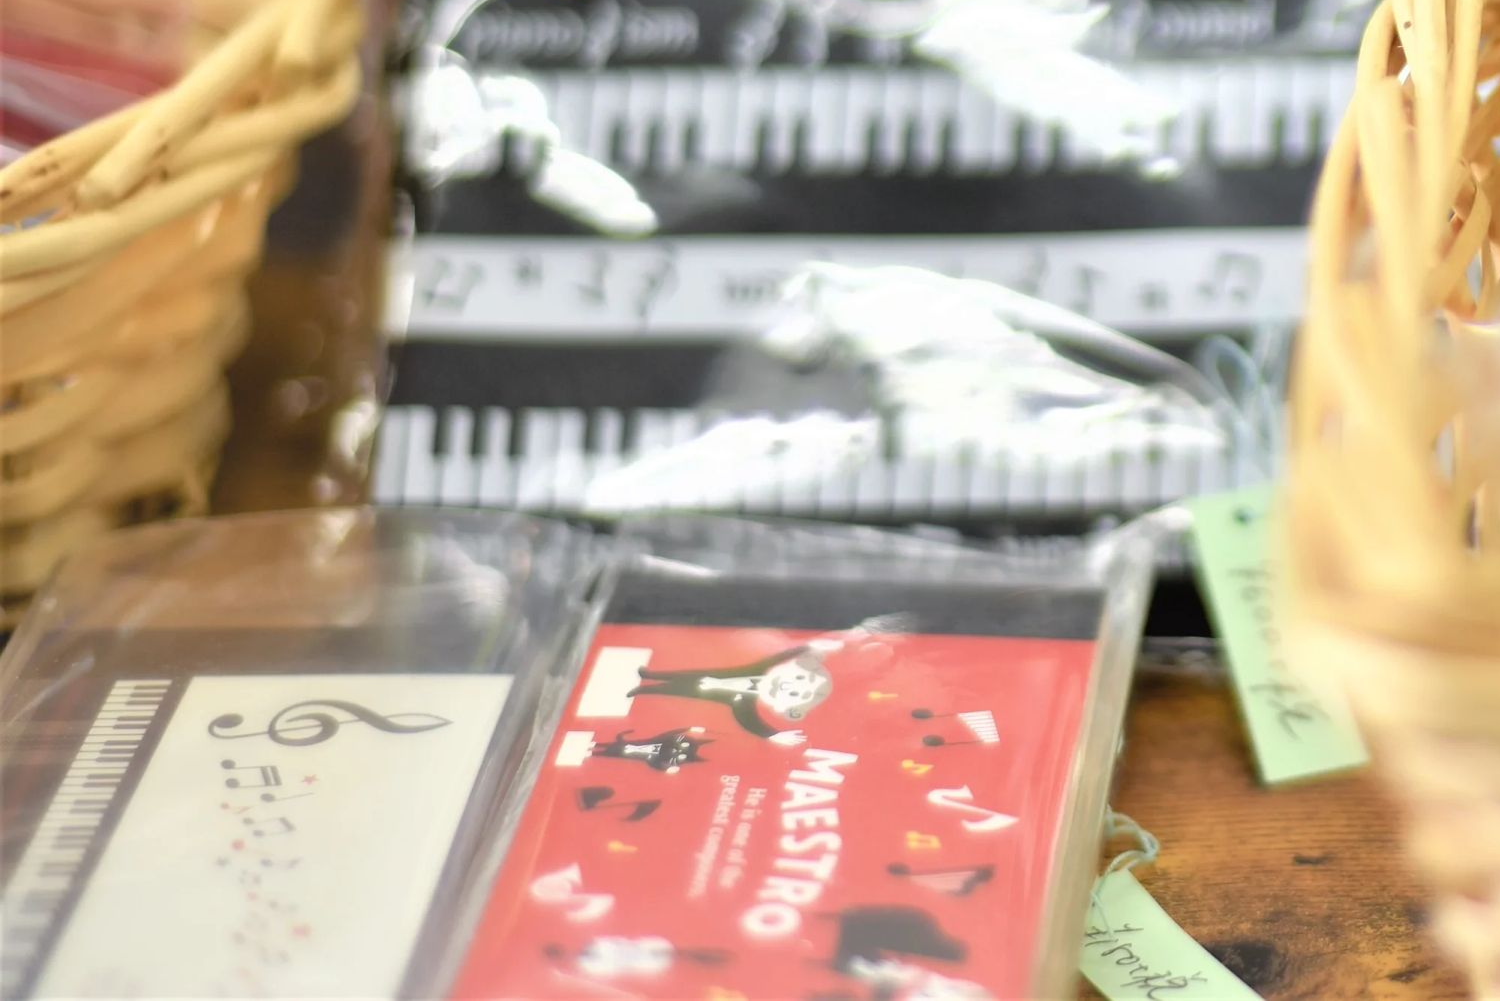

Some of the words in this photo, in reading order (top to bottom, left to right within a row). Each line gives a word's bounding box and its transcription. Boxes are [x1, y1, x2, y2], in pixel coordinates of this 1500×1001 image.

[711, 775, 741, 825] greatest
[740, 808, 763, 820] is
[744, 788, 768, 807] He
[740, 747, 859, 937] MAESTRO
